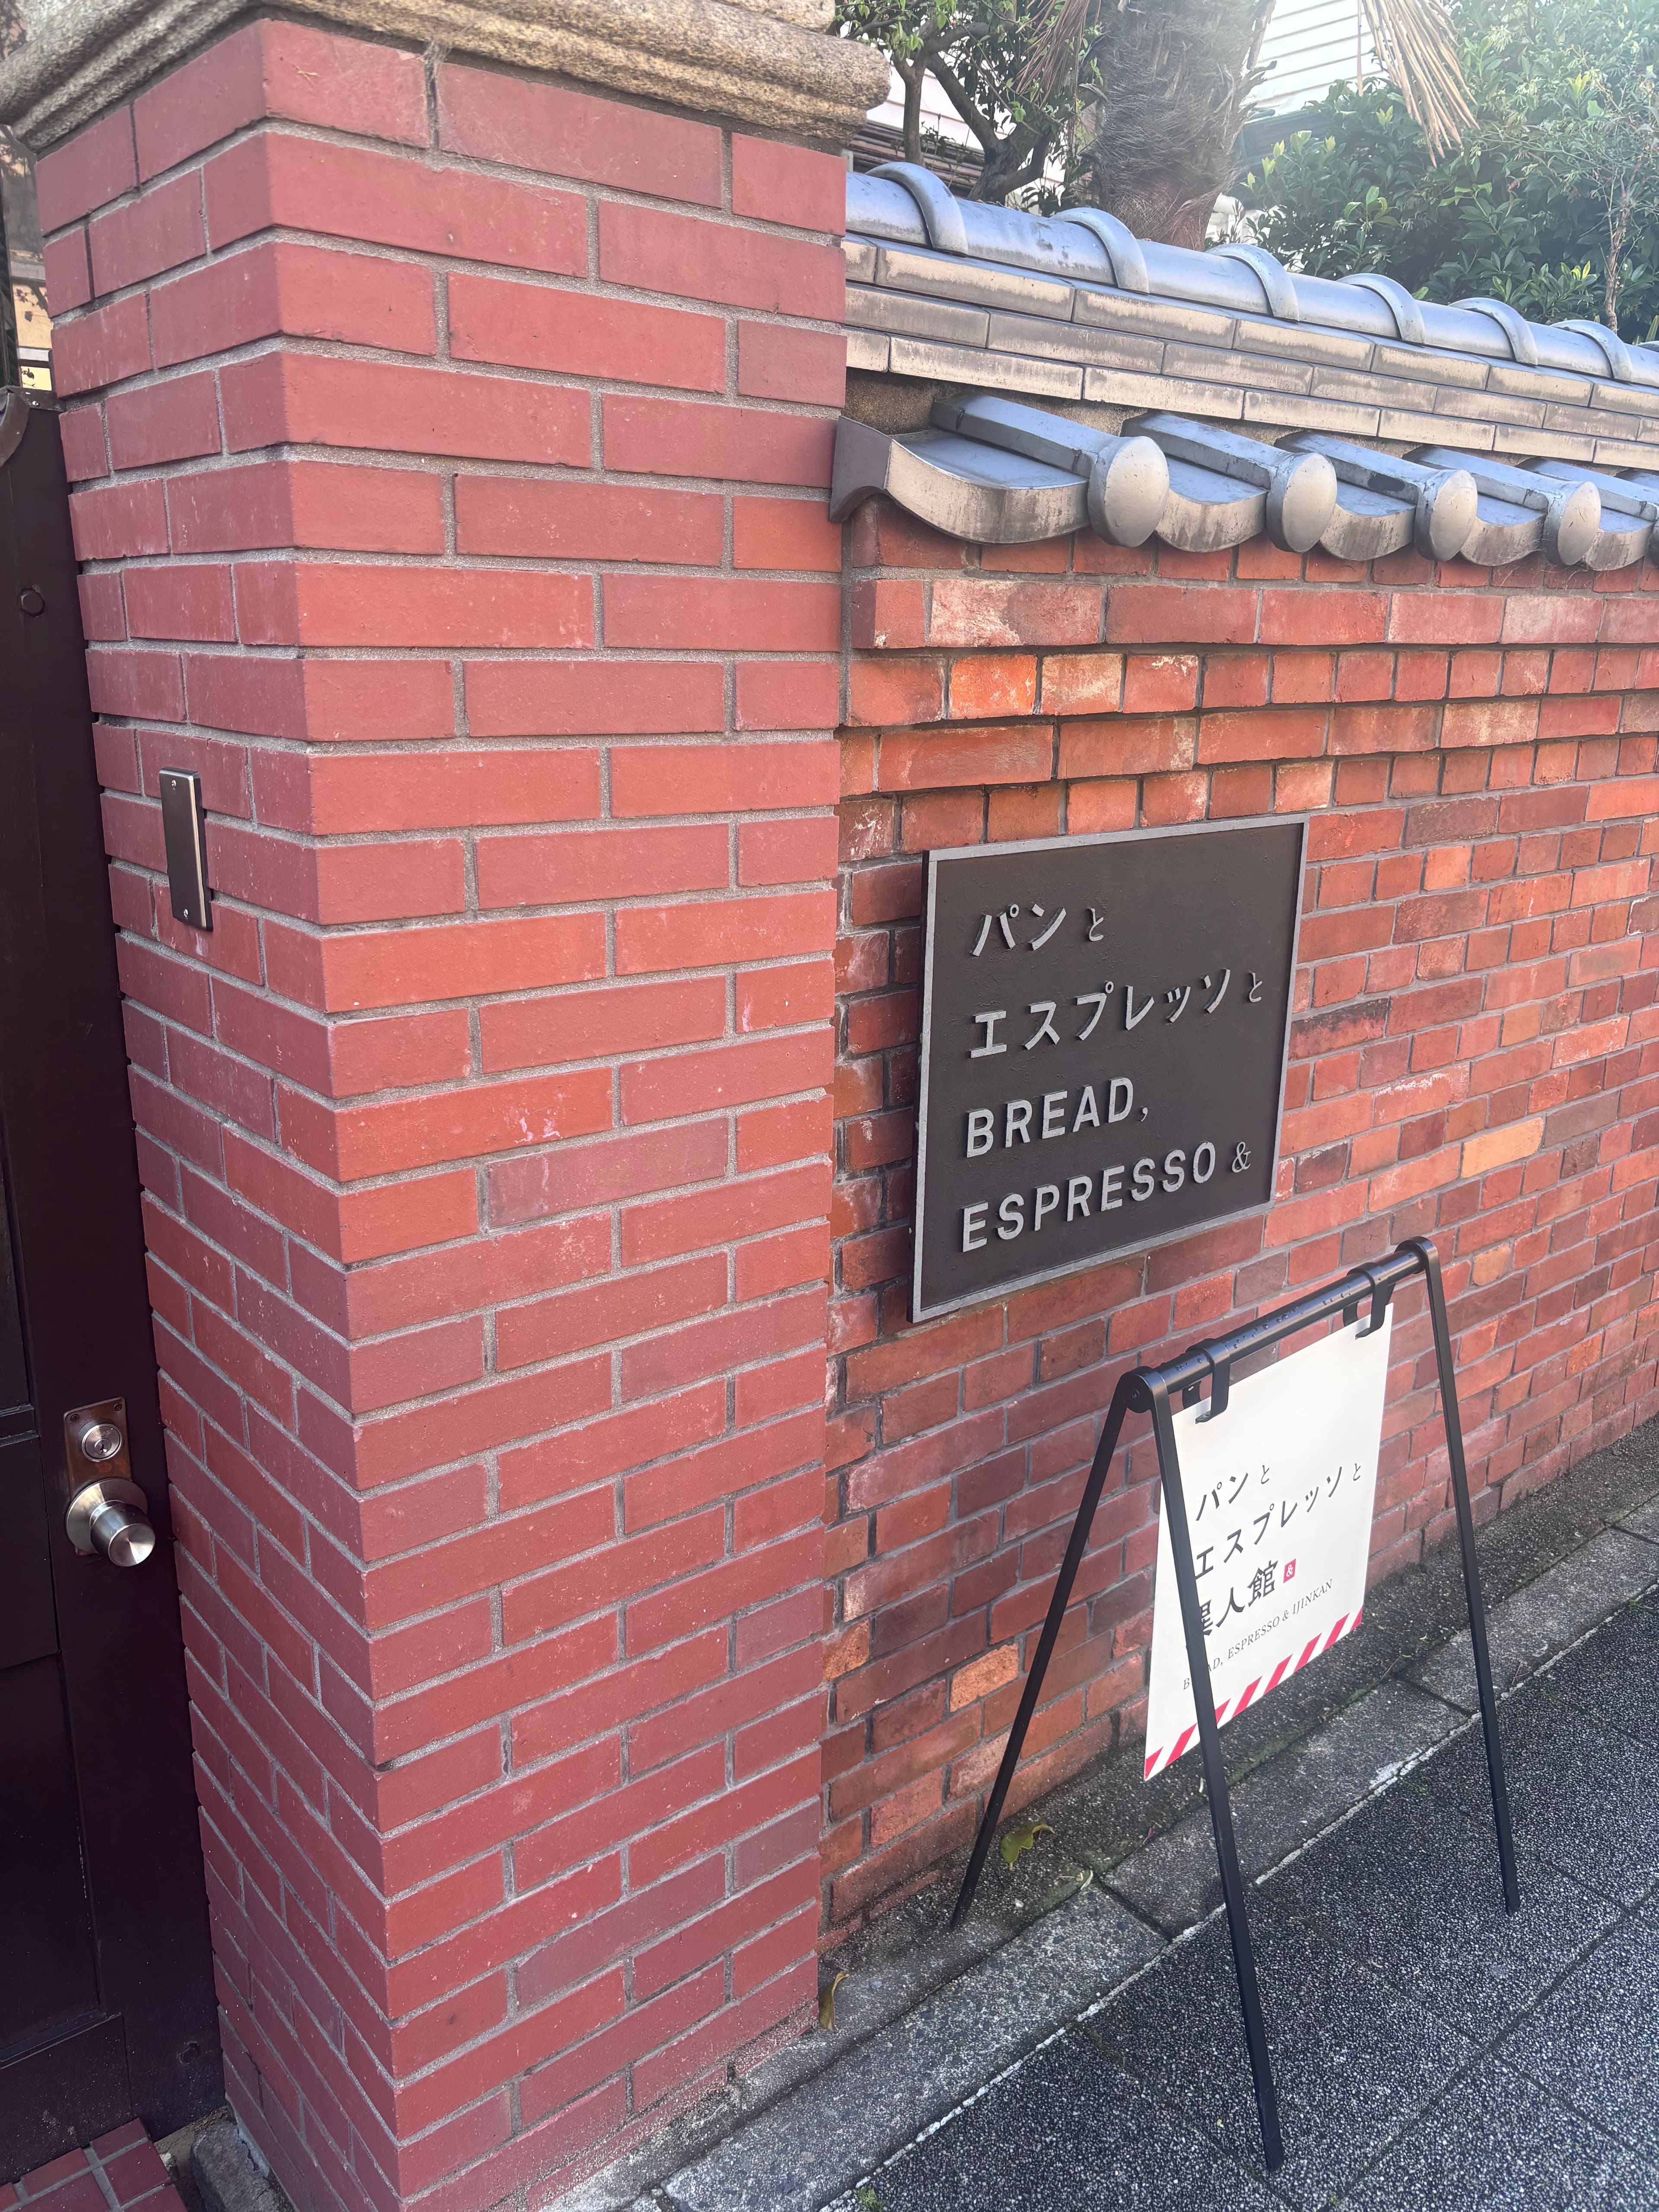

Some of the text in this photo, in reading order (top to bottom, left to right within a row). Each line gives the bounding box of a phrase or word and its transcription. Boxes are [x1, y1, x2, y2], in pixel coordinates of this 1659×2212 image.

[972, 903, 1104, 957] パンと
[970, 969, 1262, 1058] エスプレッソと
[966, 1077, 1148, 1158] BREAD,
[962, 1141, 1251, 1252] ESPRESSO &
[1195, 1465, 1269, 1521] パンと
[1195, 1463, 1361, 1580] エスプレッソと
[1286, 1564, 1294, 1577] &
[1227, 1616, 1279, 1659] ESPRESSO
[1282, 1610, 1289, 1621] &
[1292, 1579, 1333, 1615] IJINKAN
